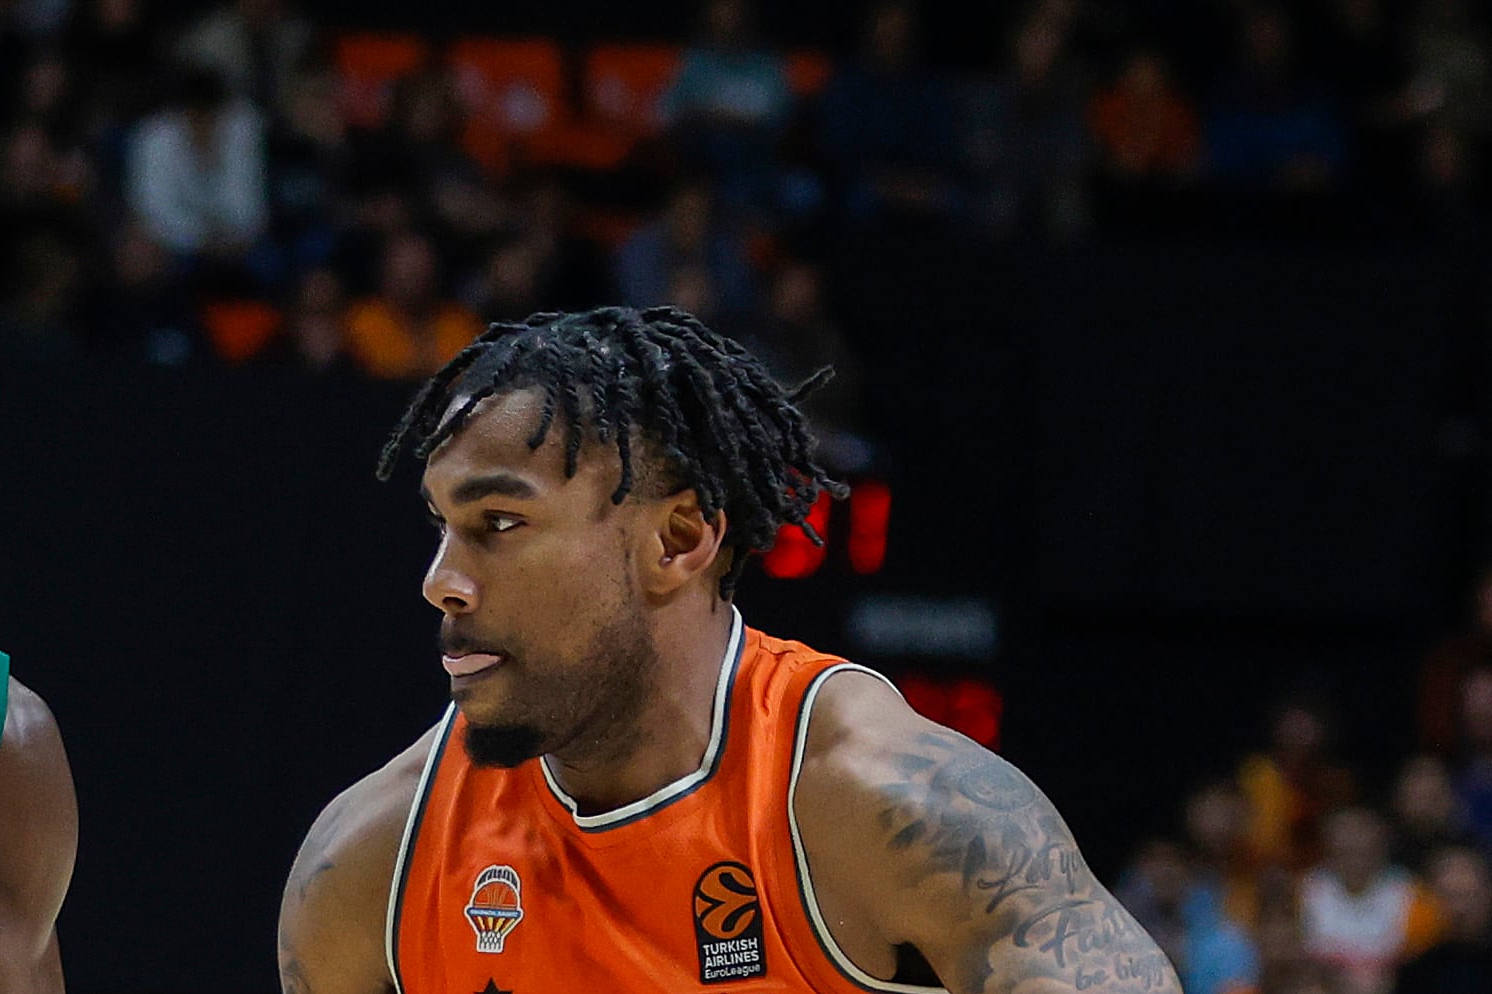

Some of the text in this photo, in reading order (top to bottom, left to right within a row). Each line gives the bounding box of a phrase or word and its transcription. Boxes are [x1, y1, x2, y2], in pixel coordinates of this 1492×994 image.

[702, 938, 758, 956] TURKISH
[704, 950, 760, 969] AIRLINES
[704, 964, 761, 979] EuroLeague
